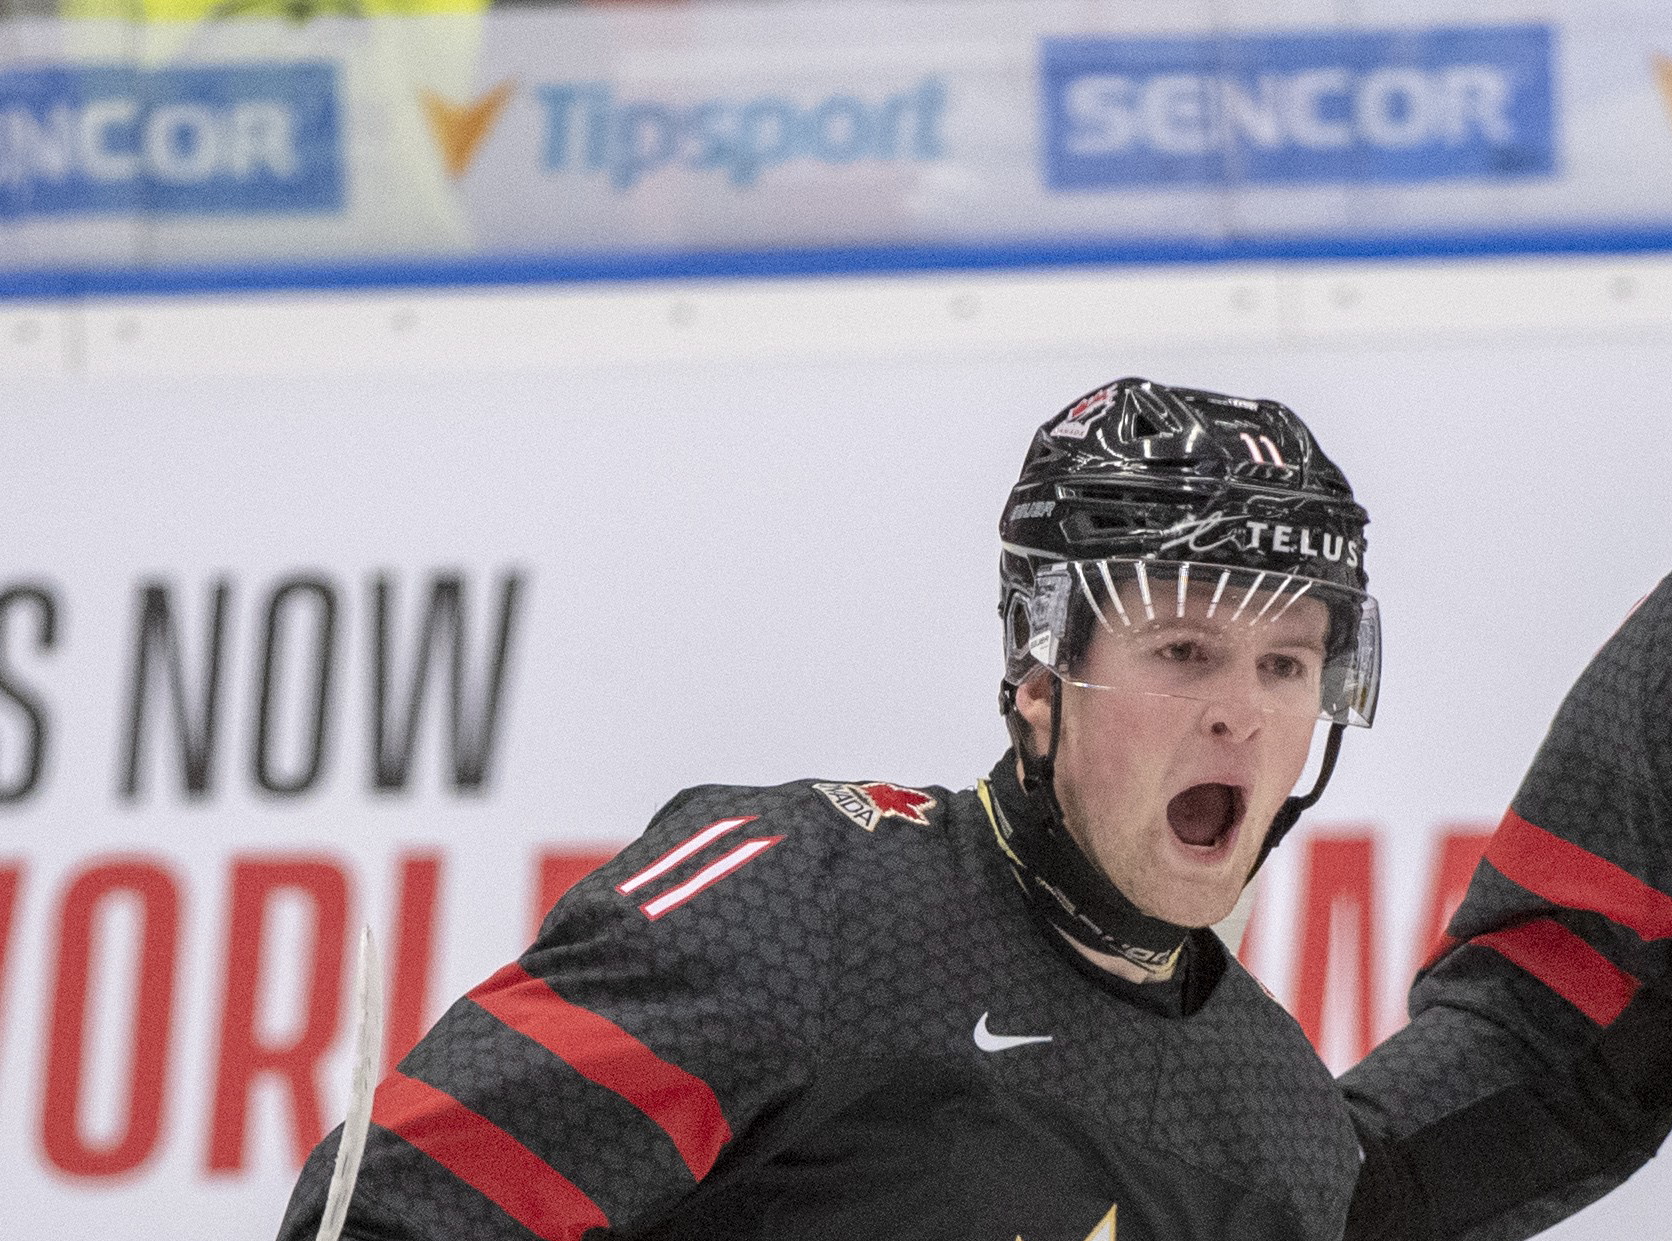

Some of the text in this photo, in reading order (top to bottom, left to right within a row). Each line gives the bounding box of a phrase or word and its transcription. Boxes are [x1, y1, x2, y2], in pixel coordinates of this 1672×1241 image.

[535, 70, 948, 194] Tipsport
[1062, 64, 1517, 155] SENCOR
[1240, 432, 1286, 467] 11
[1246, 521, 1359, 567] TELUS
[116, 573, 526, 803] NOW
[613, 814, 787, 922] 11
